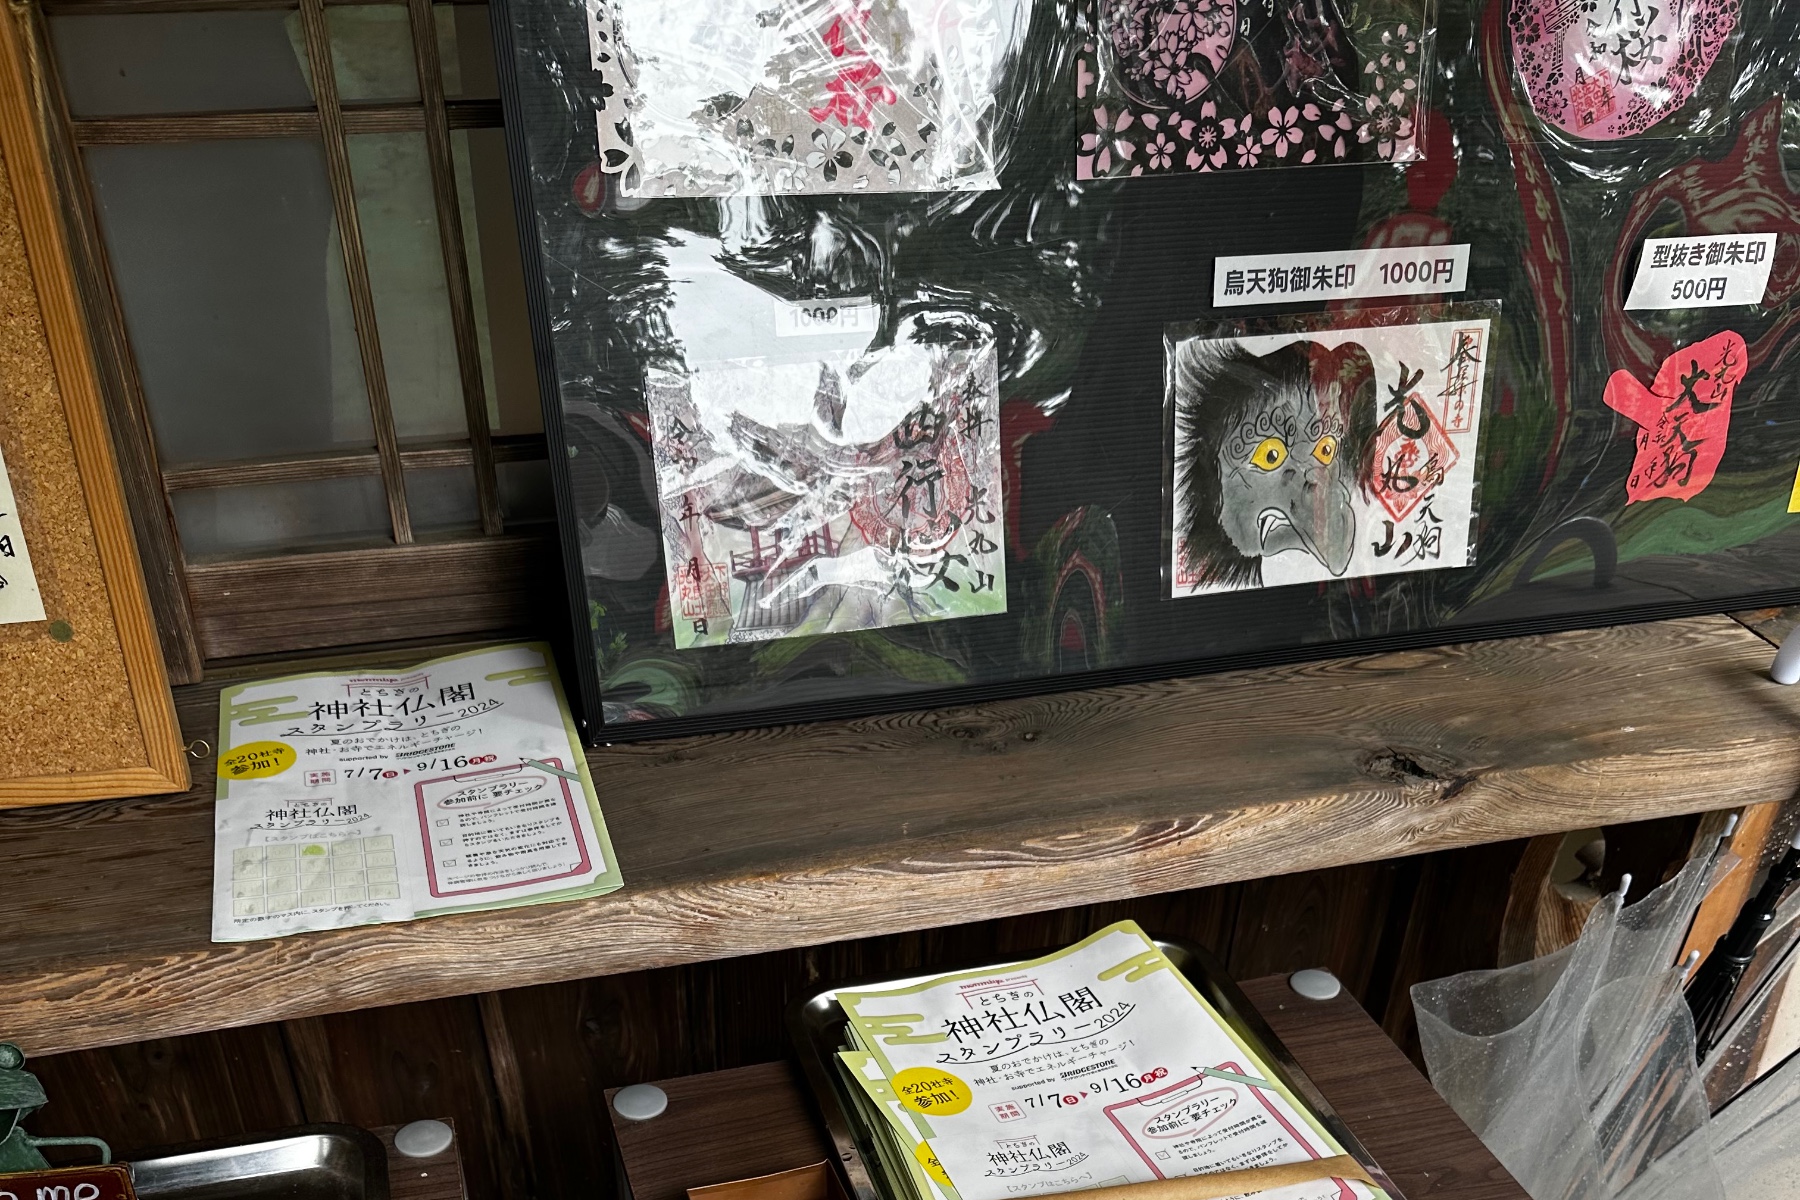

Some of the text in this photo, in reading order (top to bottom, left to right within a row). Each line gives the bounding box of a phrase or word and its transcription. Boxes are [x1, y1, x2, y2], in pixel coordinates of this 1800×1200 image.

[1651, 241, 1767, 268] 型抜き御朱印
[1224, 258, 1455, 296] 烏天狗御朱印 1000円
[1670, 277, 1727, 300] 500円
[308, 682, 475, 721] 神社仏閣
[360, 687, 420, 697] とちぎの
[280, 699, 500, 737] スタンプラリー2024
[224, 747, 285, 767] 全20社寺
[231, 758, 280, 775] 参加！
[417, 754, 469, 772] 9/16
[457, 781, 529, 797] スタンプラリー
[265, 804, 357, 821] 神社仏閣
[980, 990, 1034, 1007] とちぎの
[941, 986, 1103, 1044] 神社仏閣
[936, 1001, 1131, 1063] スタンプラリー2024
[989, 1038, 1109, 1073] 夏のおでかけは、とちぎの
[1059, 1059, 1116, 1080] BRIDGESTONE
[902, 1076, 954, 1096] 全20社寺
[1089, 1073, 1142, 1093] 9/16
[914, 1089, 960, 1109] 参加！
[1154, 1096, 1220, 1124] スタンプラリー
[1147, 1098, 1238, 1135] 参加前に 要チェック
[986, 1141, 1072, 1166] 神社仏閣
